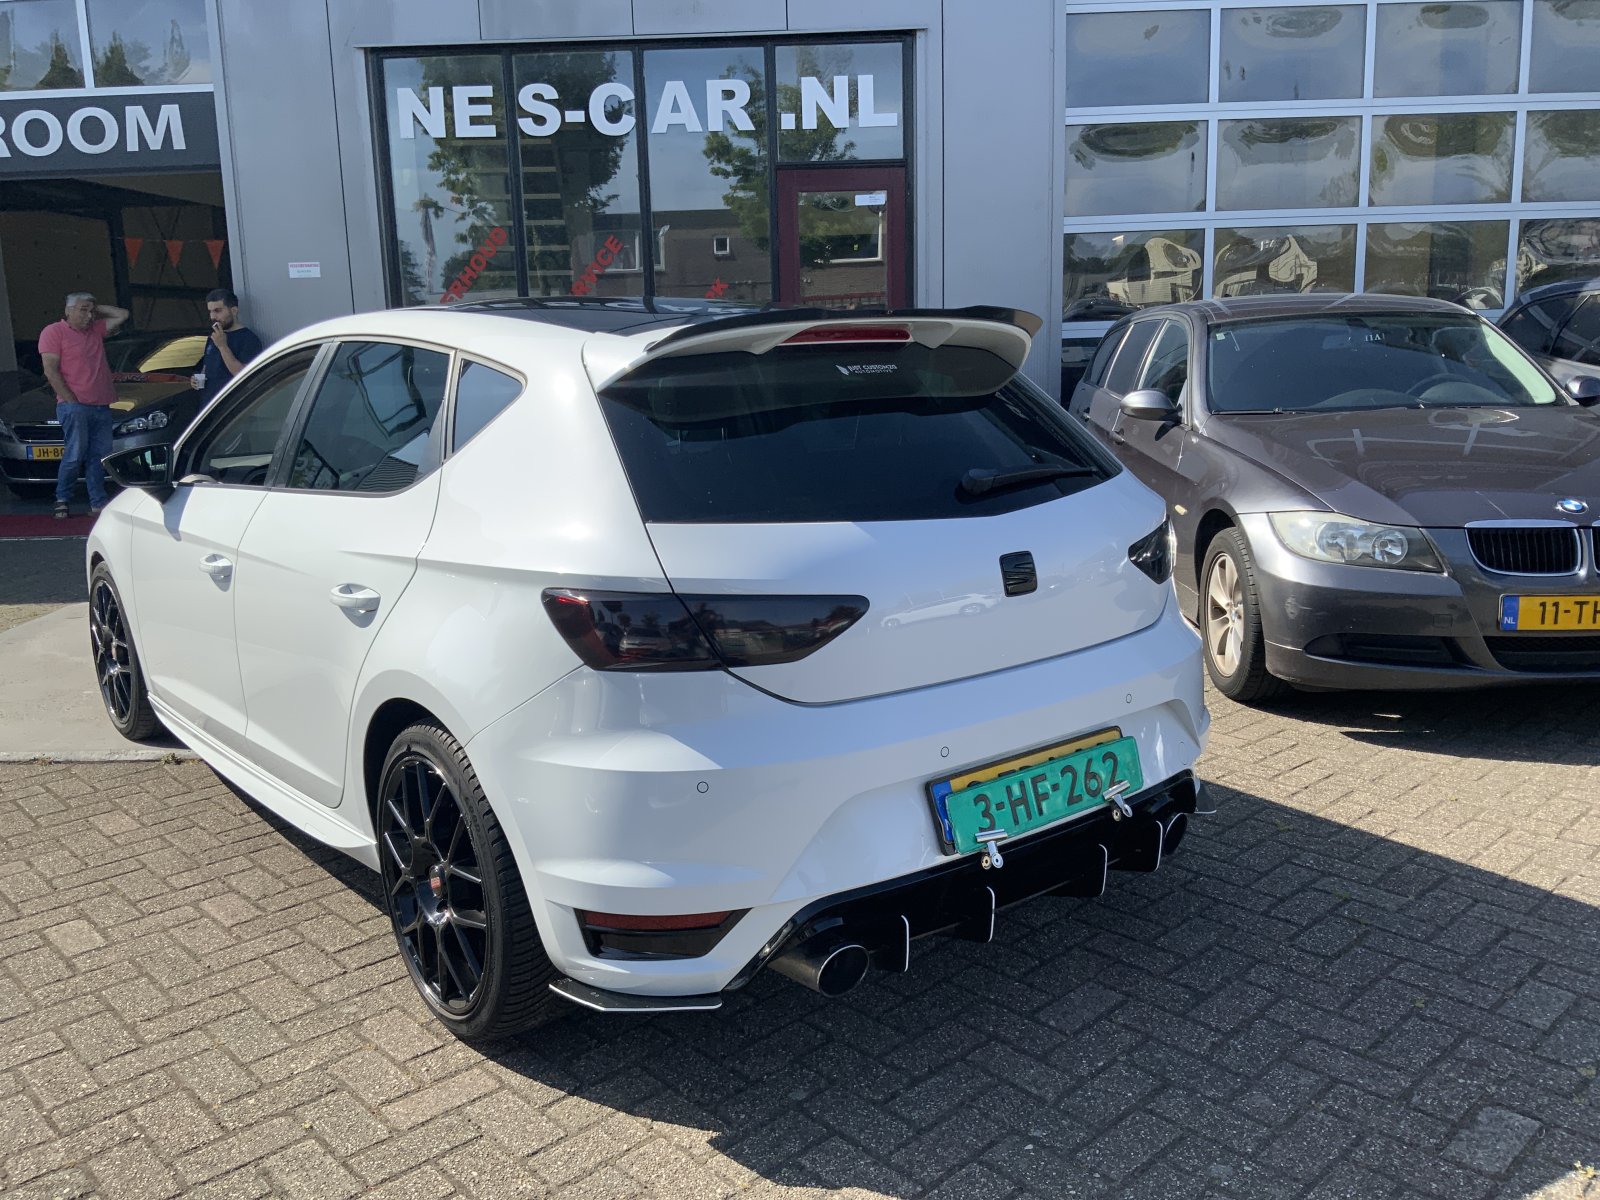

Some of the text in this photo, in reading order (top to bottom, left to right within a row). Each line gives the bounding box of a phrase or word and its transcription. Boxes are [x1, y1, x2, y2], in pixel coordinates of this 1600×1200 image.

[0, 104, 187, 158] OOM
[1503, 616, 1516, 625] NL
[973, 751, 1124, 832] 3-HF-262
